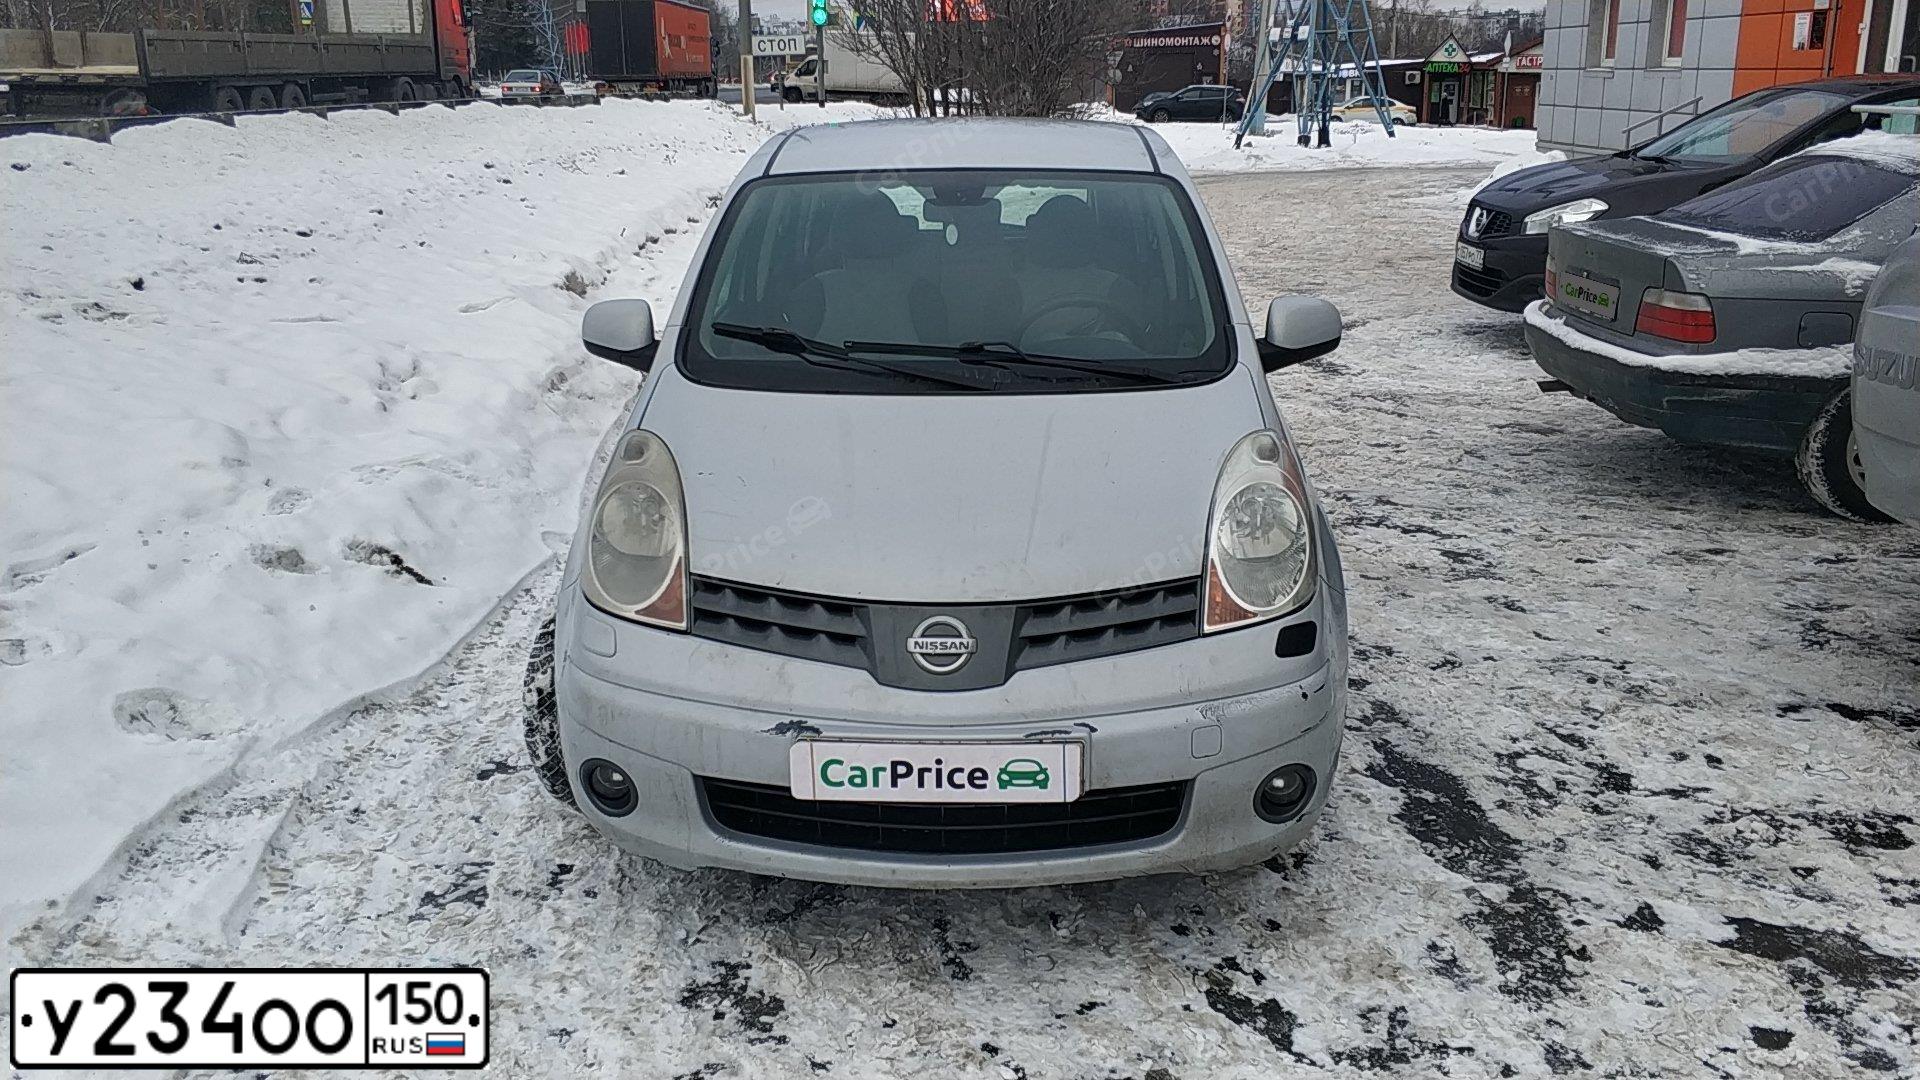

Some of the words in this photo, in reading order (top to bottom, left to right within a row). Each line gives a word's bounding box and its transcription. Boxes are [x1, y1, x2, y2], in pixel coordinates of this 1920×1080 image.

[757, 38, 798, 52] СТОП
[1133, 36, 1211, 48] ШИНОМОНТАЖ
[1516, 56, 1544, 67] ГАСТР
[1426, 62, 1459, 73] АПТЕКА
[1853, 344, 1920, 391] SUZU
[913, 640, 970, 650] NISSAN
